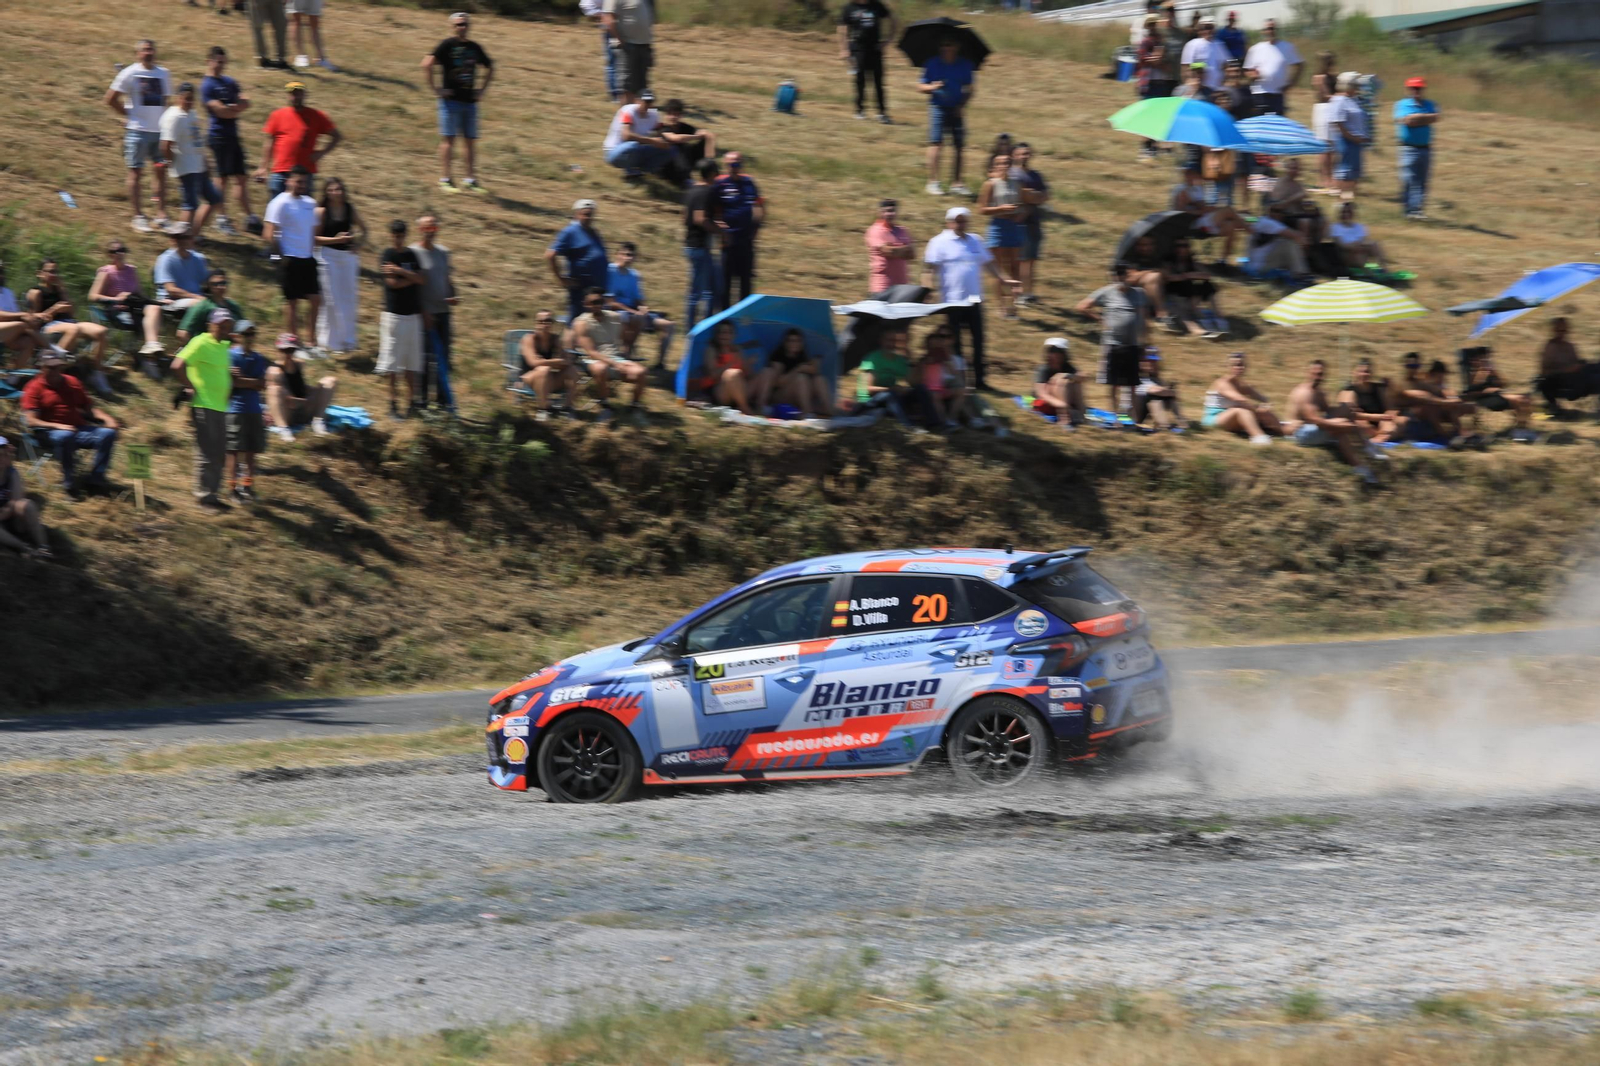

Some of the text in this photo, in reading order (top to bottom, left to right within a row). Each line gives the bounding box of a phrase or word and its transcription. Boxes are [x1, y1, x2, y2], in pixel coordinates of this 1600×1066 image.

[849, 596, 900, 611] A.Blanco
[911, 593, 948, 623] 20
[852, 612, 889, 626] D.Villa
[695, 662, 725, 680] 20
[808, 677, 942, 708] Blanco
